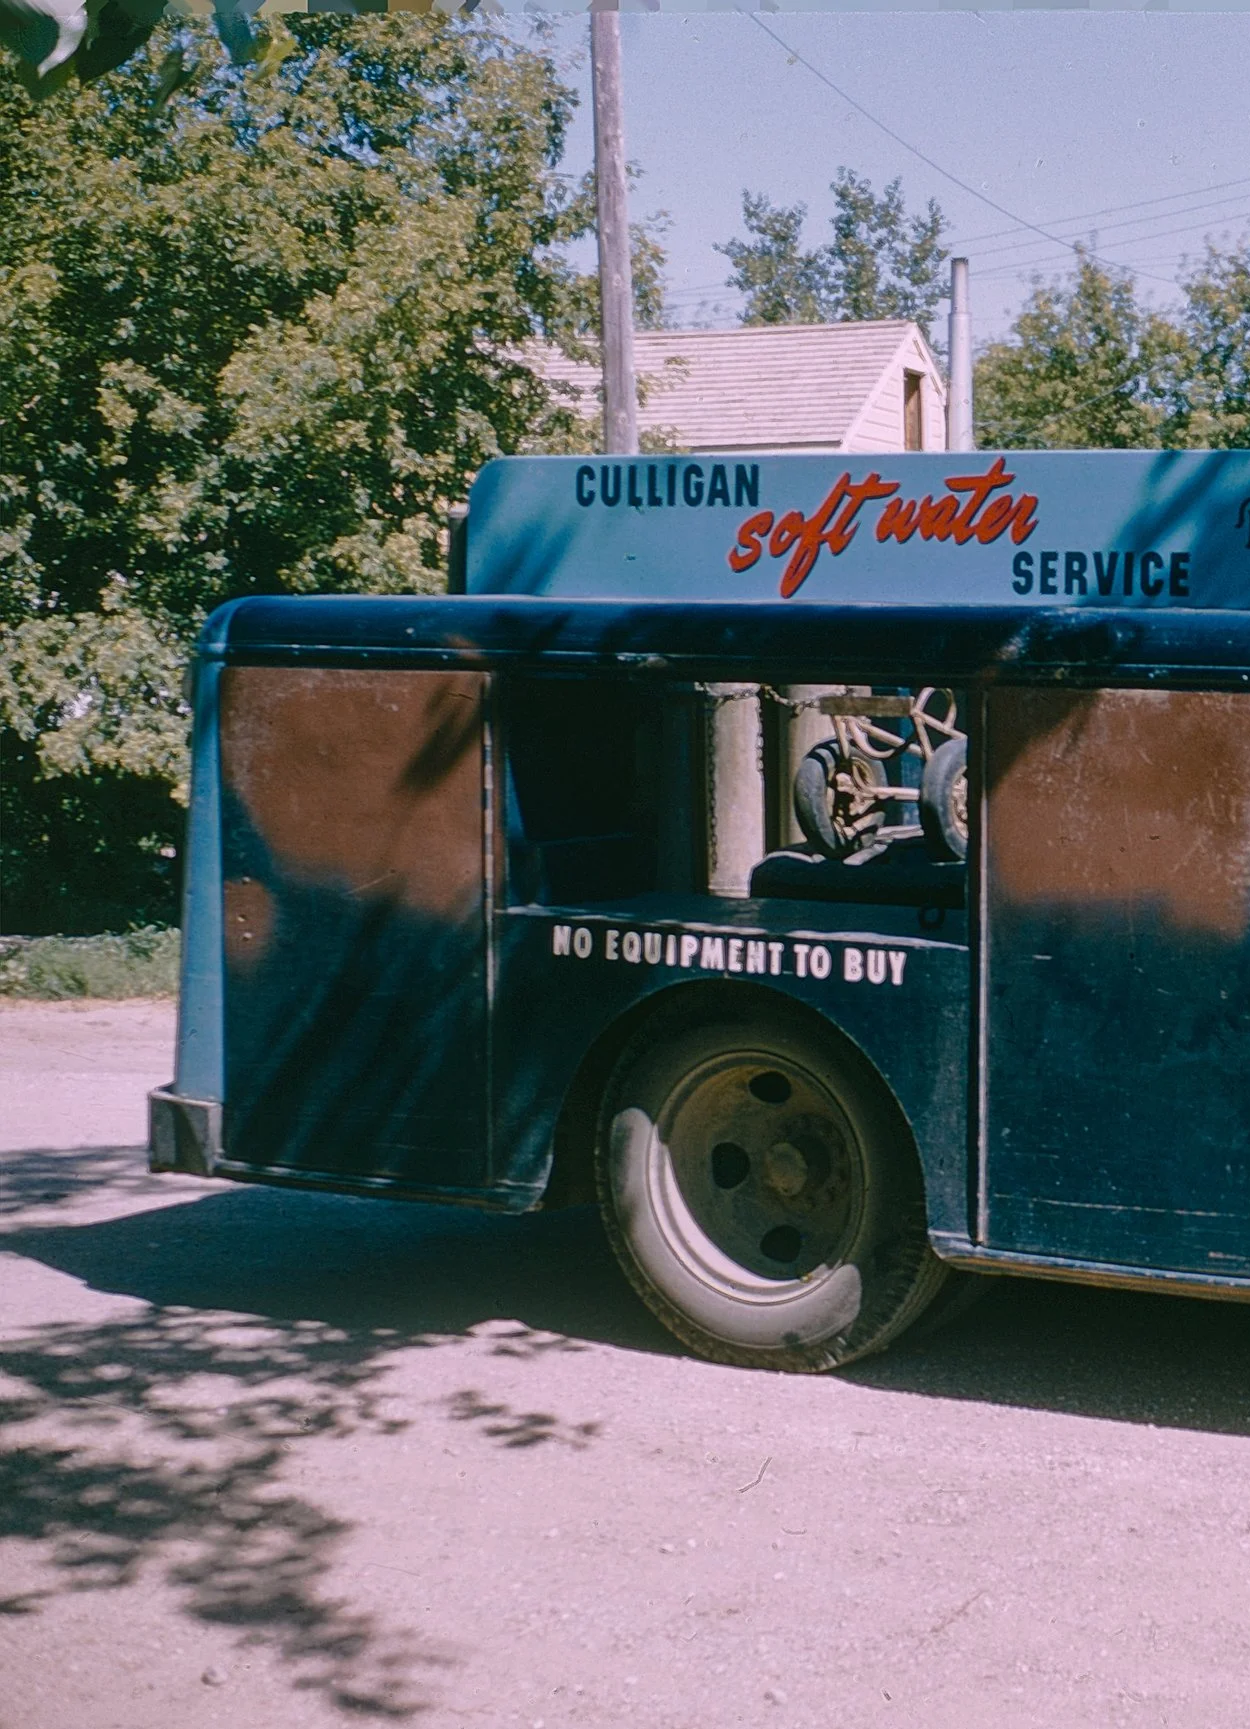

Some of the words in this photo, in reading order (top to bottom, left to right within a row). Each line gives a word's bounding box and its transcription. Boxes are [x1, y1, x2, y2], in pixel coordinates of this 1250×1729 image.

[576, 464, 760, 507] CULLIGAN
[729, 471, 900, 599] soft
[876, 457, 1040, 546] water
[1012, 552, 1191, 597] SERVICE
[553, 925, 593, 959] NO
[604, 929, 785, 976] EQUIPMENT
[793, 944, 832, 979] TO
[843, 948, 907, 986] BUY
